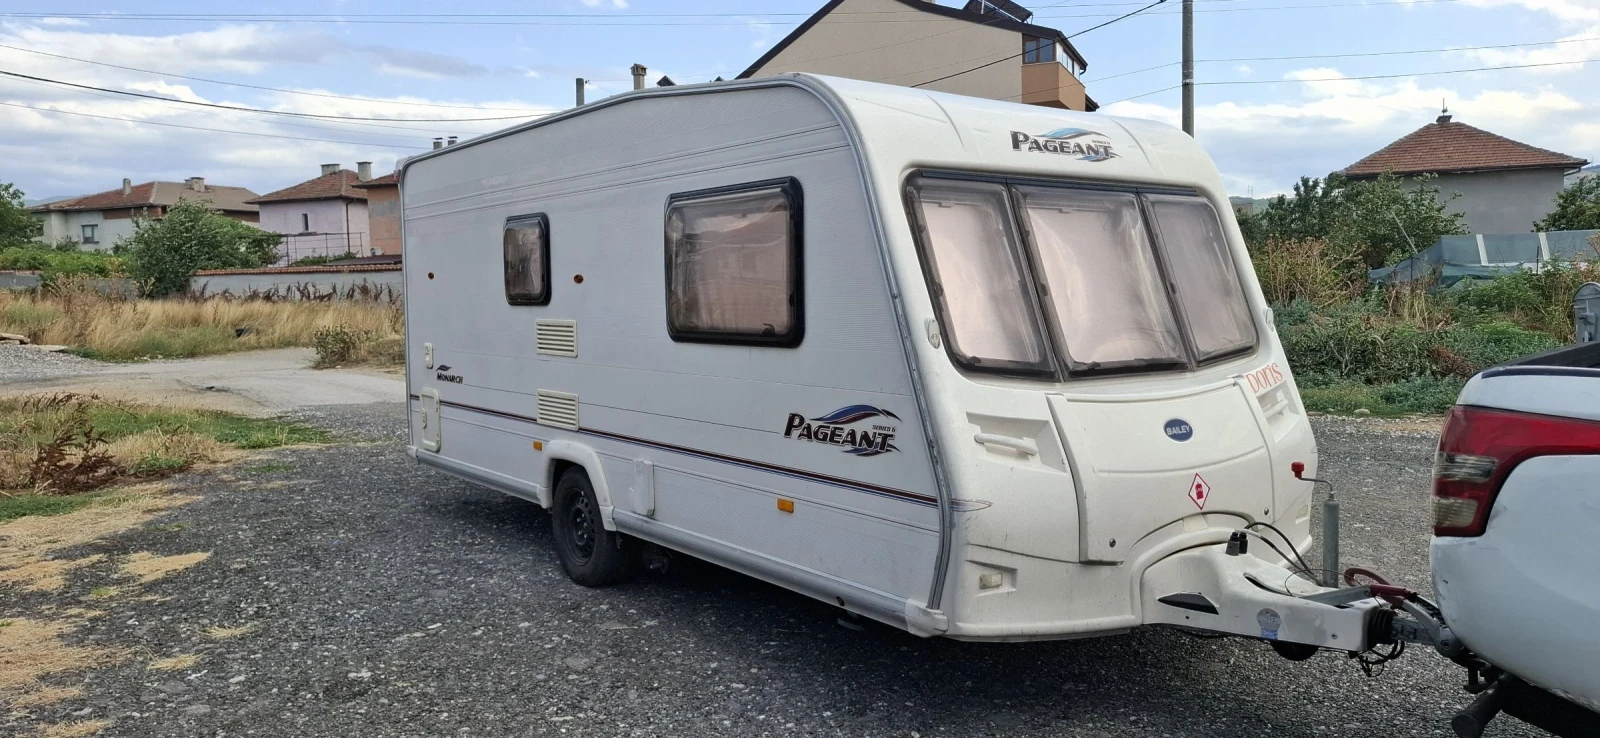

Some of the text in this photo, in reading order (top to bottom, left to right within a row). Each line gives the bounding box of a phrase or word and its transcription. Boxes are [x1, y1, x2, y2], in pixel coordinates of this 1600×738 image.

[1244, 362, 1283, 394] Doris
[872, 424, 891, 432] SERIES
[1166, 425, 1190, 436] BAILEY
